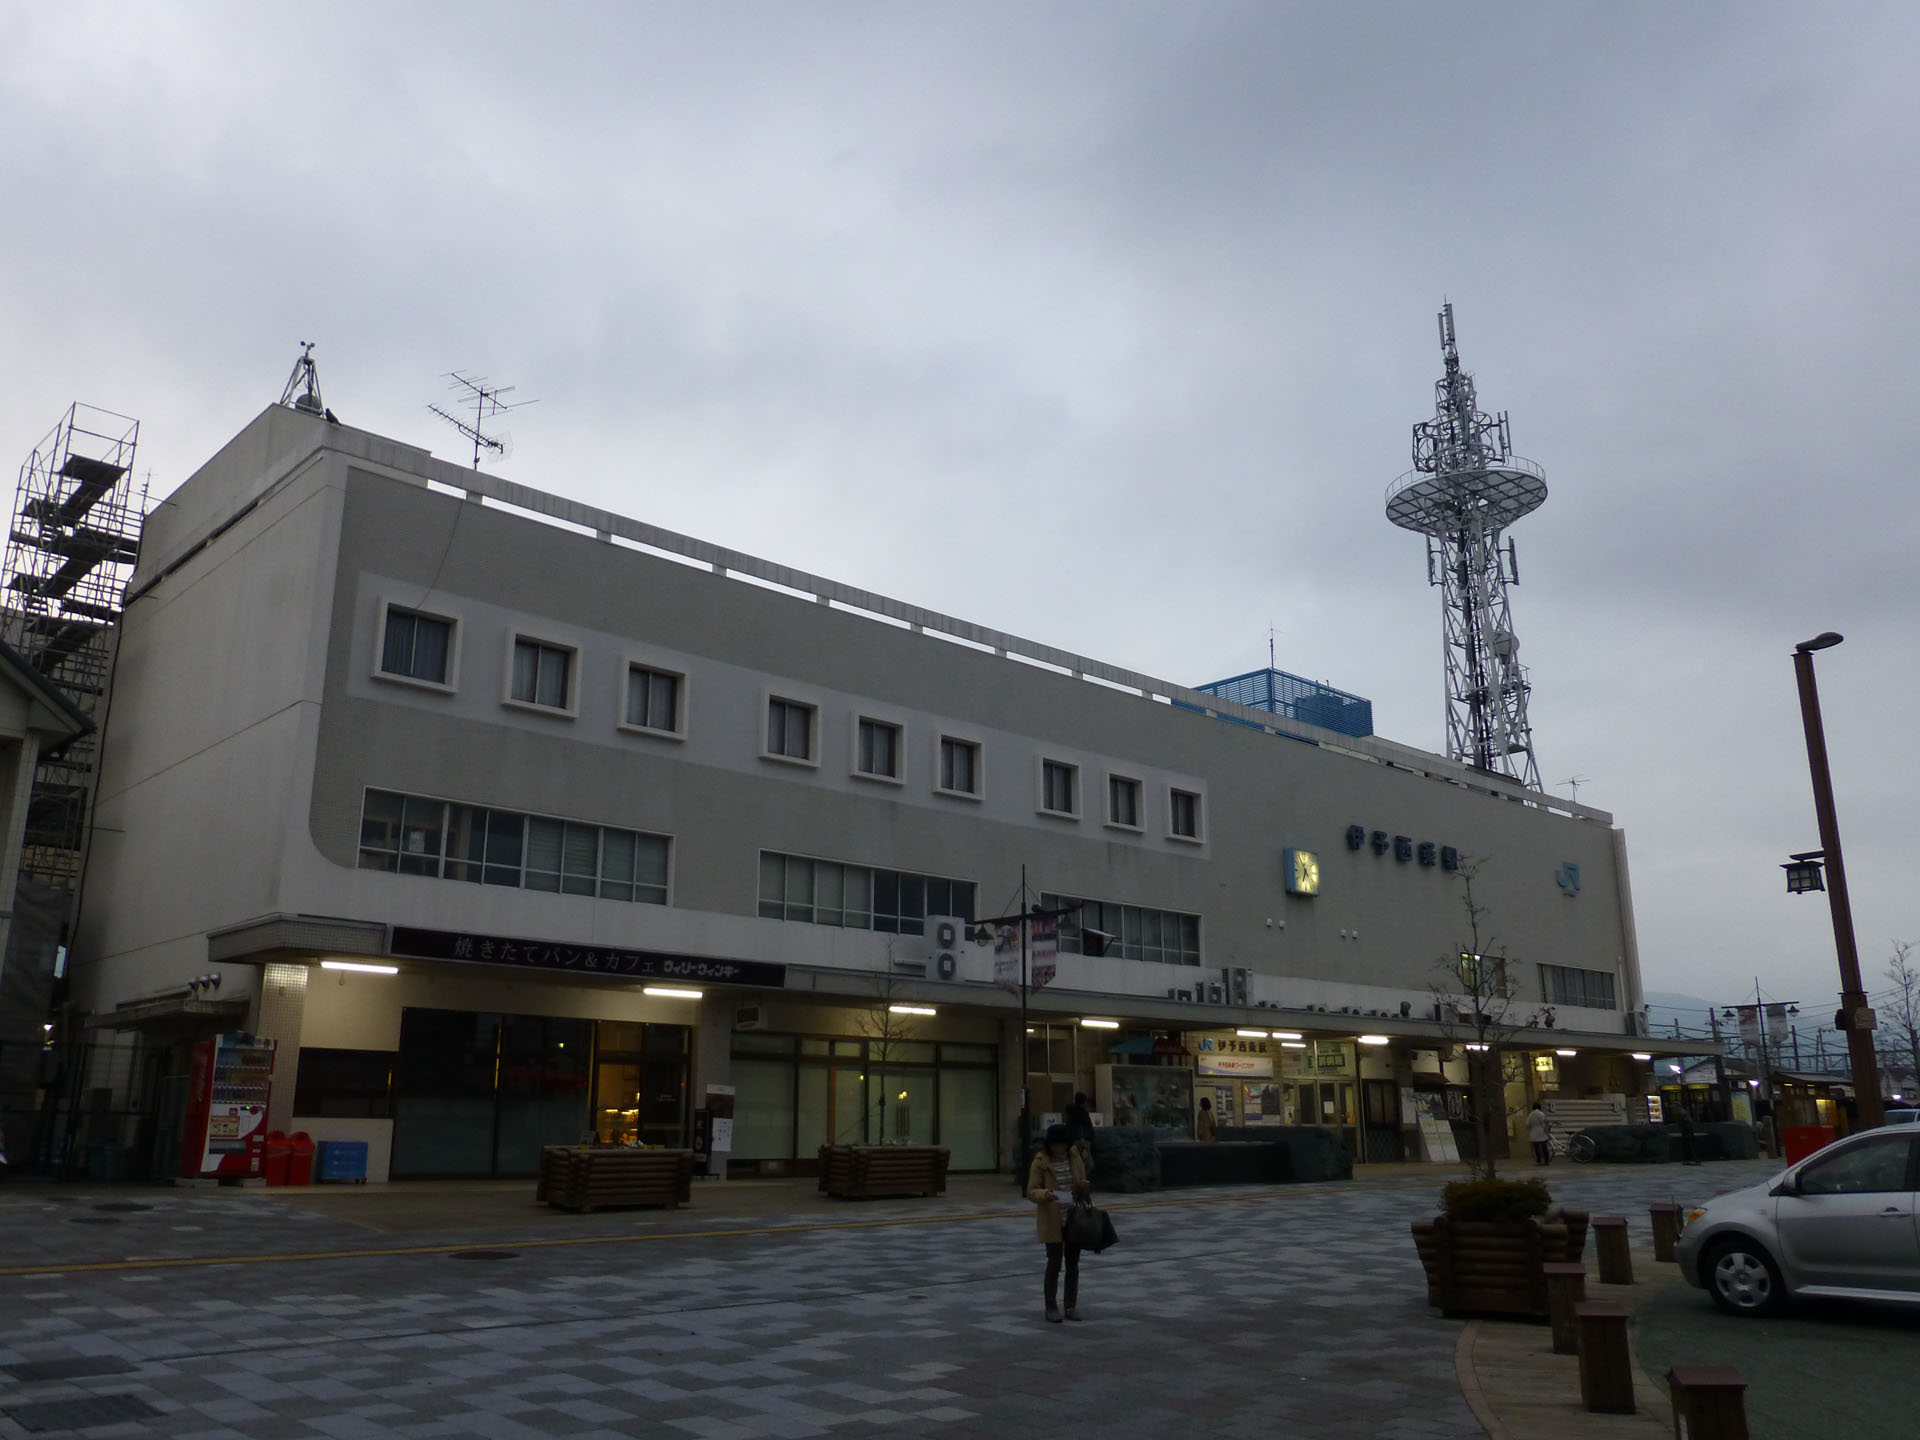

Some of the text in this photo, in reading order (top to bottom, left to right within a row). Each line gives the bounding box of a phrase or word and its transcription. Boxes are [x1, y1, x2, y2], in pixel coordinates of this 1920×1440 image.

[1348, 825, 1458, 870] 伊予西条駅
[1555, 861, 1580, 892] JR
[1198, 1038, 1266, 1053] JR 伊予西条駅
